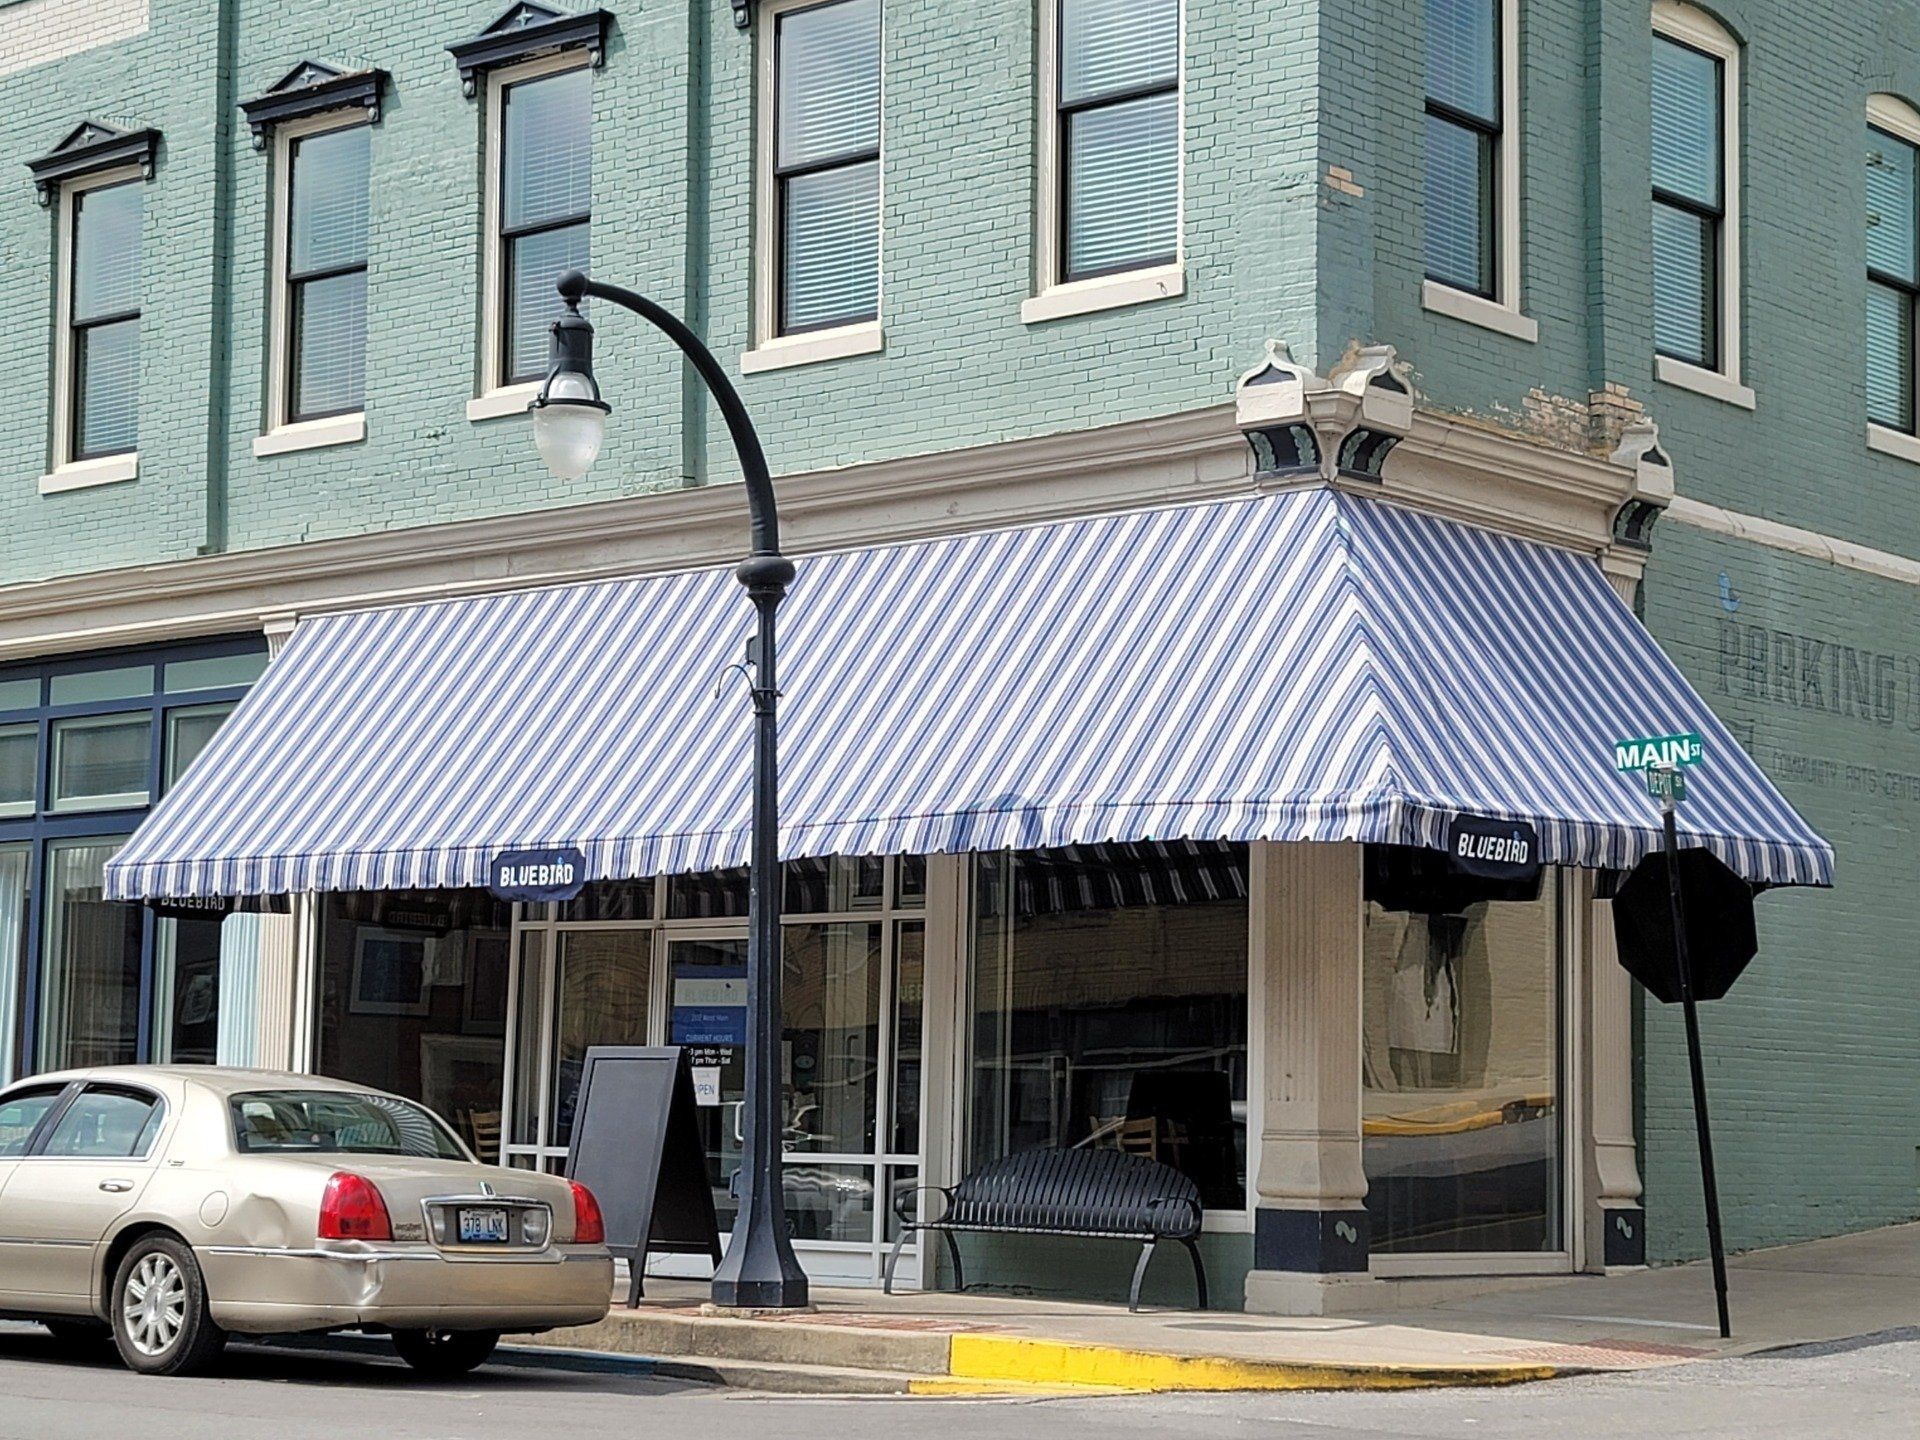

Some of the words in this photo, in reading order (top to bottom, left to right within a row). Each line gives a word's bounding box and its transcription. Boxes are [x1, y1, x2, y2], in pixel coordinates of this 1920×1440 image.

[1616, 739, 1691, 769] MAIN
[1690, 743, 1701, 757] ST
[1458, 832, 1529, 865] BLUEBIRD
[500, 863, 574, 888] BLUEBIRD
[464, 1217, 481, 1233] 378
